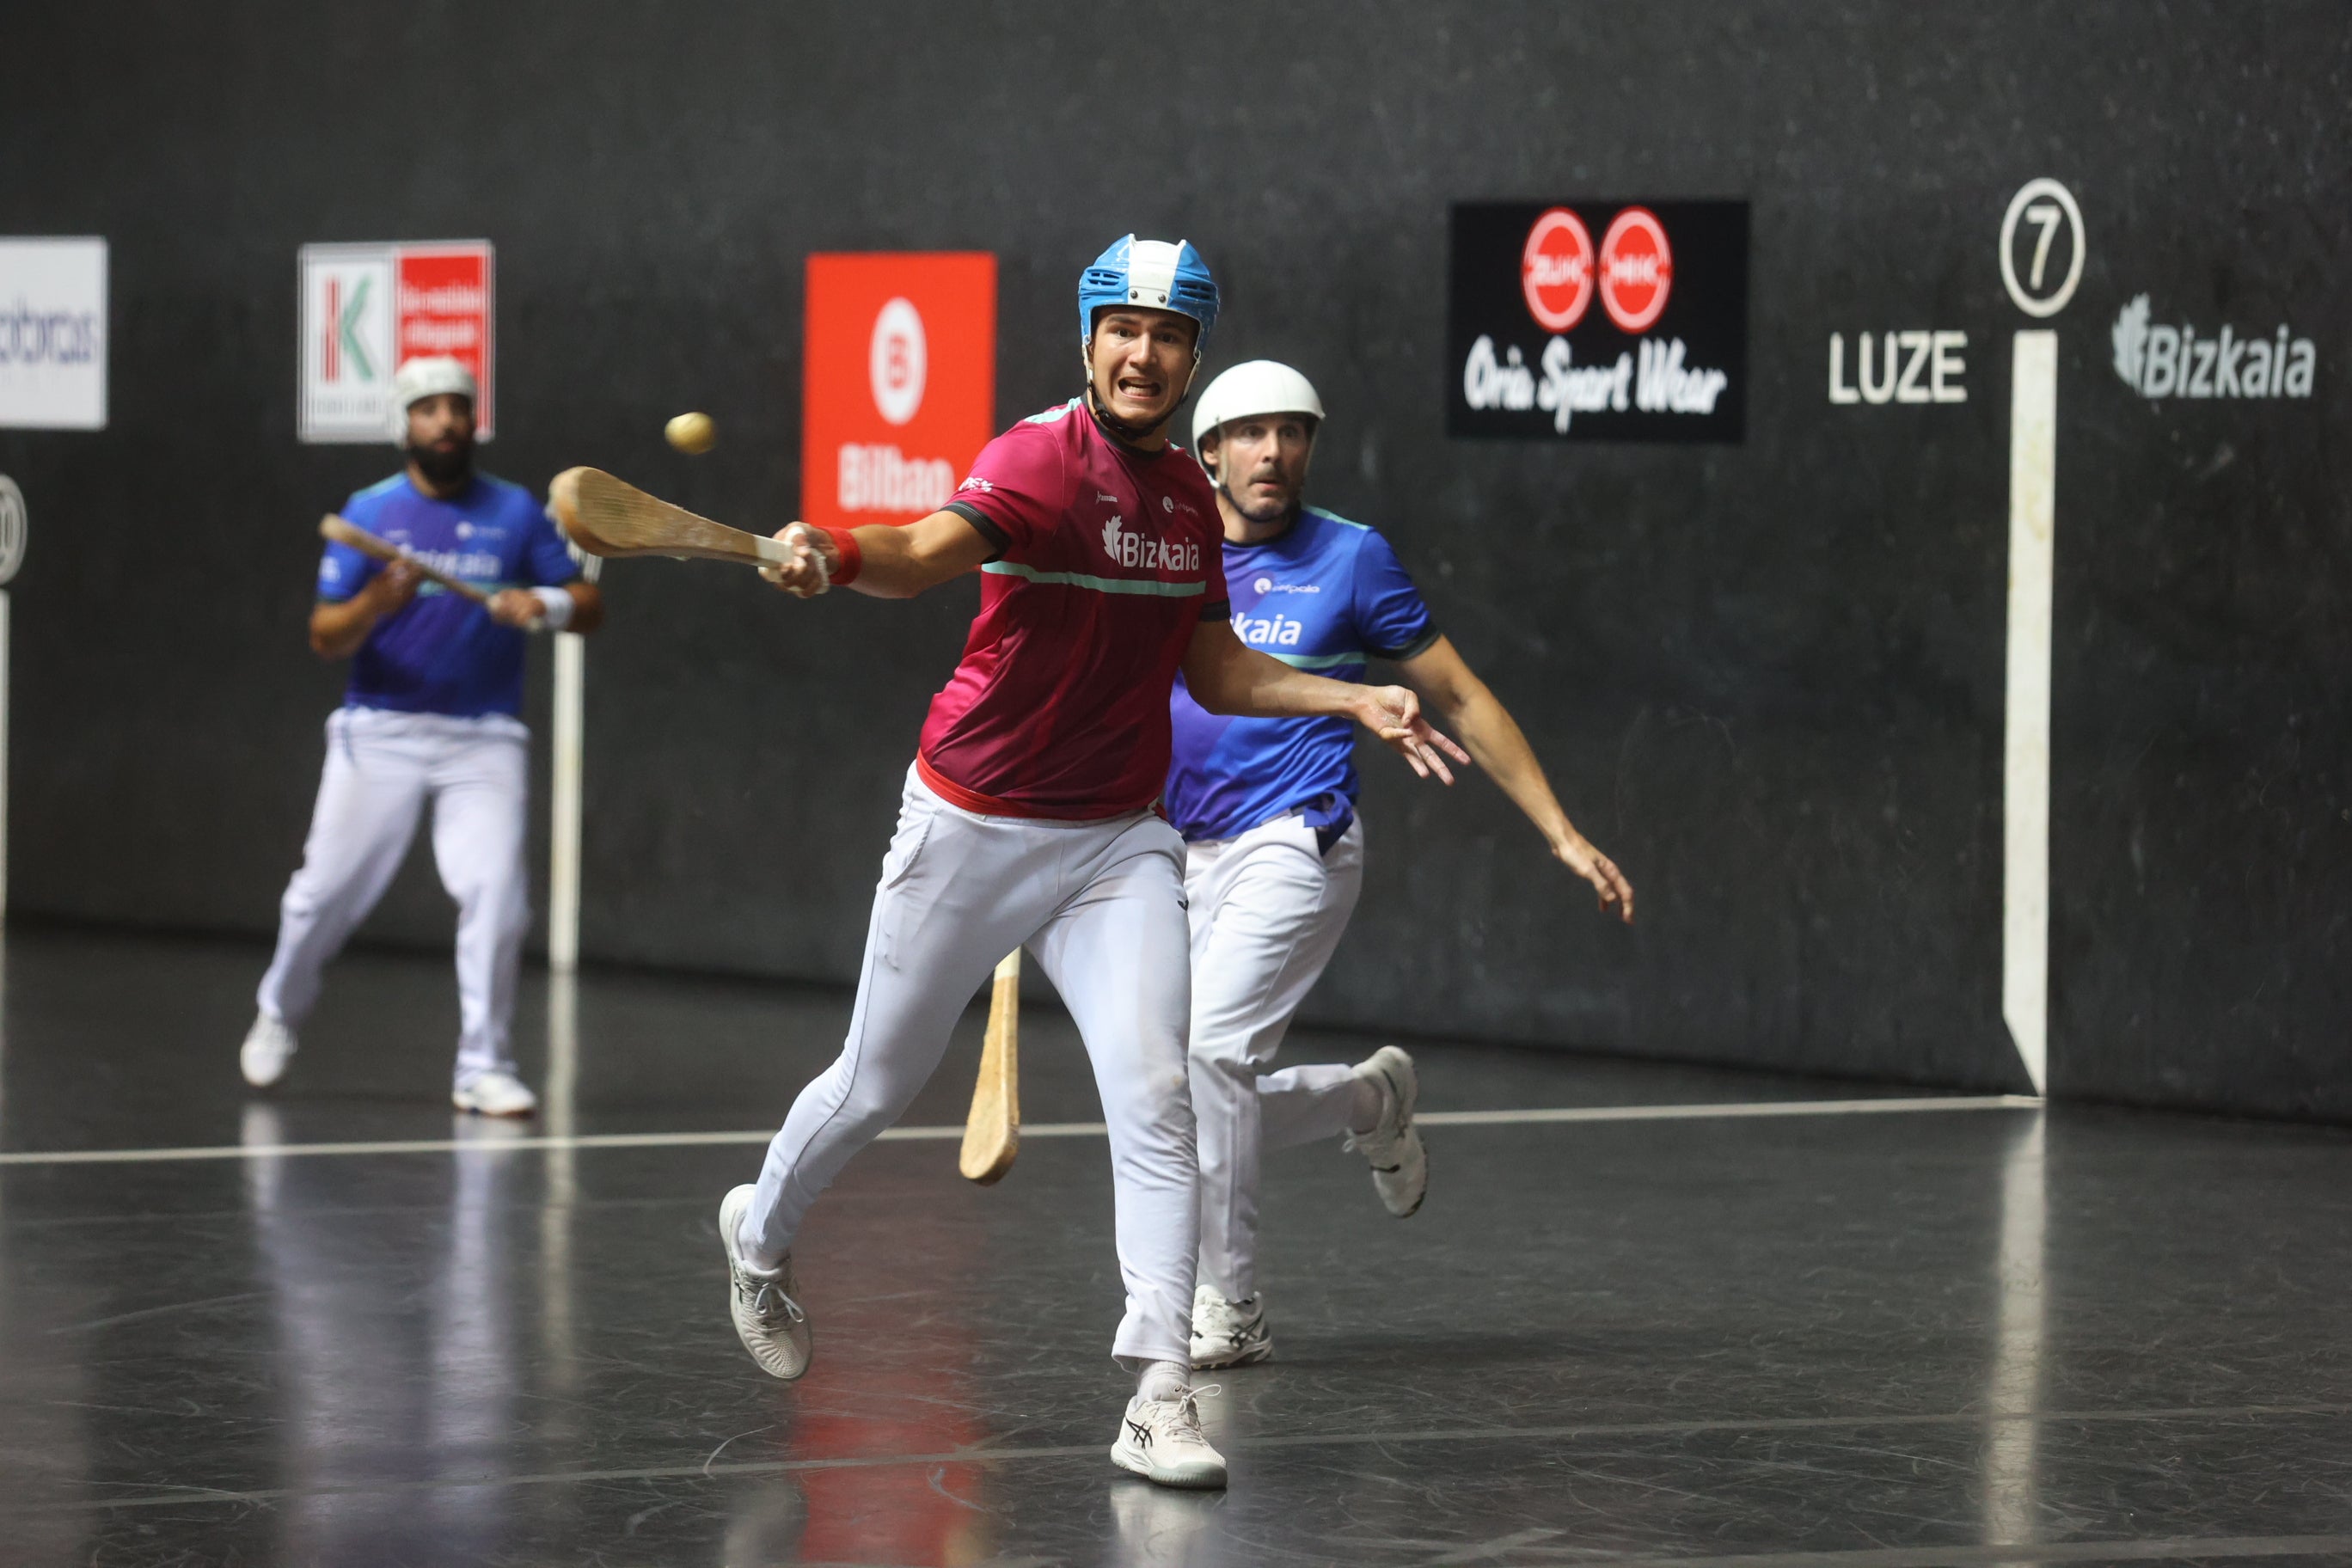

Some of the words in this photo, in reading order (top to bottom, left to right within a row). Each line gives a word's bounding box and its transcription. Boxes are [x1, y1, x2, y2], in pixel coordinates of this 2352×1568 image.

[2026, 205, 2061, 290] 7
[1828, 330, 1969, 405] LUZE
[2142, 323, 2317, 398] Bizkaia
[837, 442, 955, 513] Bilbao
[1123, 532, 1199, 572] Bizkaia
[1230, 612, 1302, 646] kaia
